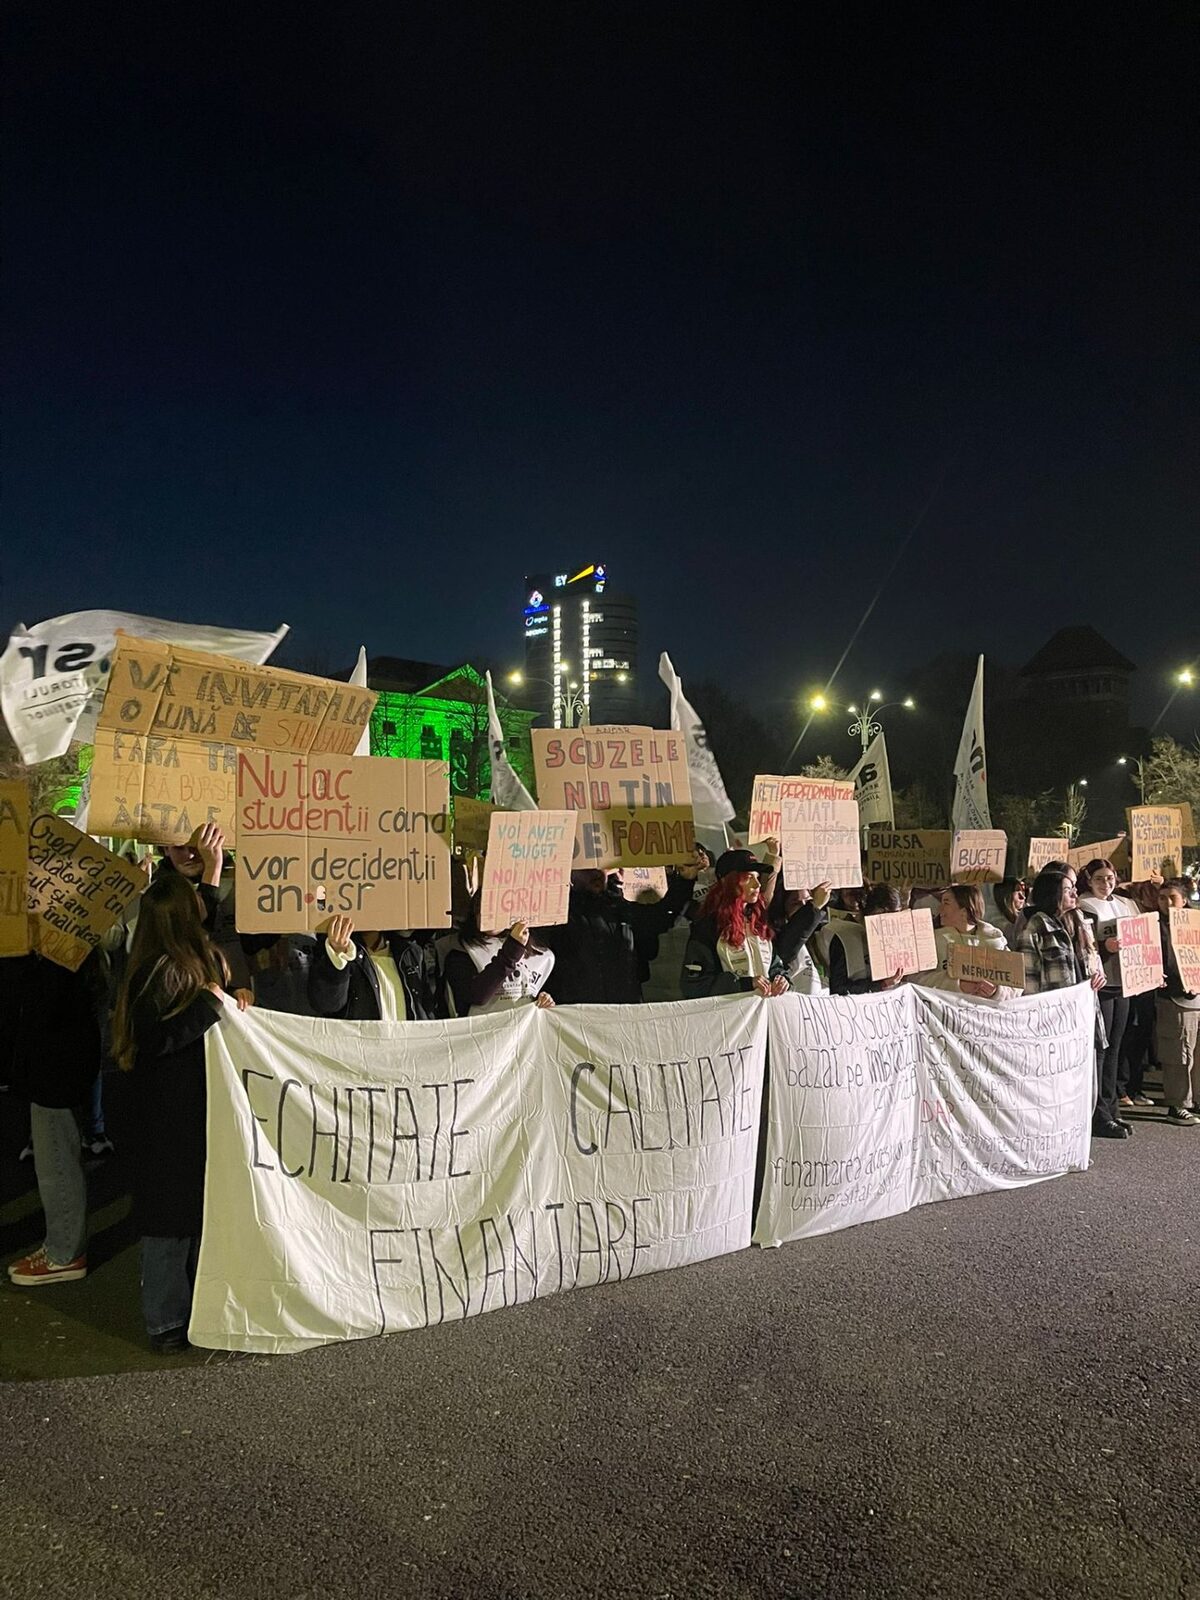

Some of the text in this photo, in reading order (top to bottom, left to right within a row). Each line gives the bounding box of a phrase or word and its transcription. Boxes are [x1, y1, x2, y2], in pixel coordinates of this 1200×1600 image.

[555, 574, 567, 586] EY
[120, 697, 143, 723] O
[154, 702, 221, 735] LUNĂ
[232, 711, 261, 741] DE
[546, 738, 680, 768] SCUZELE
[237, 752, 353, 801] Nu tac
[564, 781, 611, 810] NU
[379, 804, 447, 834] când
[612, 819, 696, 857] FOAME
[870, 833, 924, 849] BURSA
[30, 813, 83, 857] Cred
[104, 870, 136, 898] am
[242, 855, 300, 881] vor
[806, 846, 829, 861] NU
[959, 848, 1004, 867] BUGET
[798, 995, 867, 1046] ANOSR
[787, 1047, 843, 1089] bazat
[847, 1063, 864, 1093] pe
[242, 1046, 753, 1183] ECHITATE CALITATE
